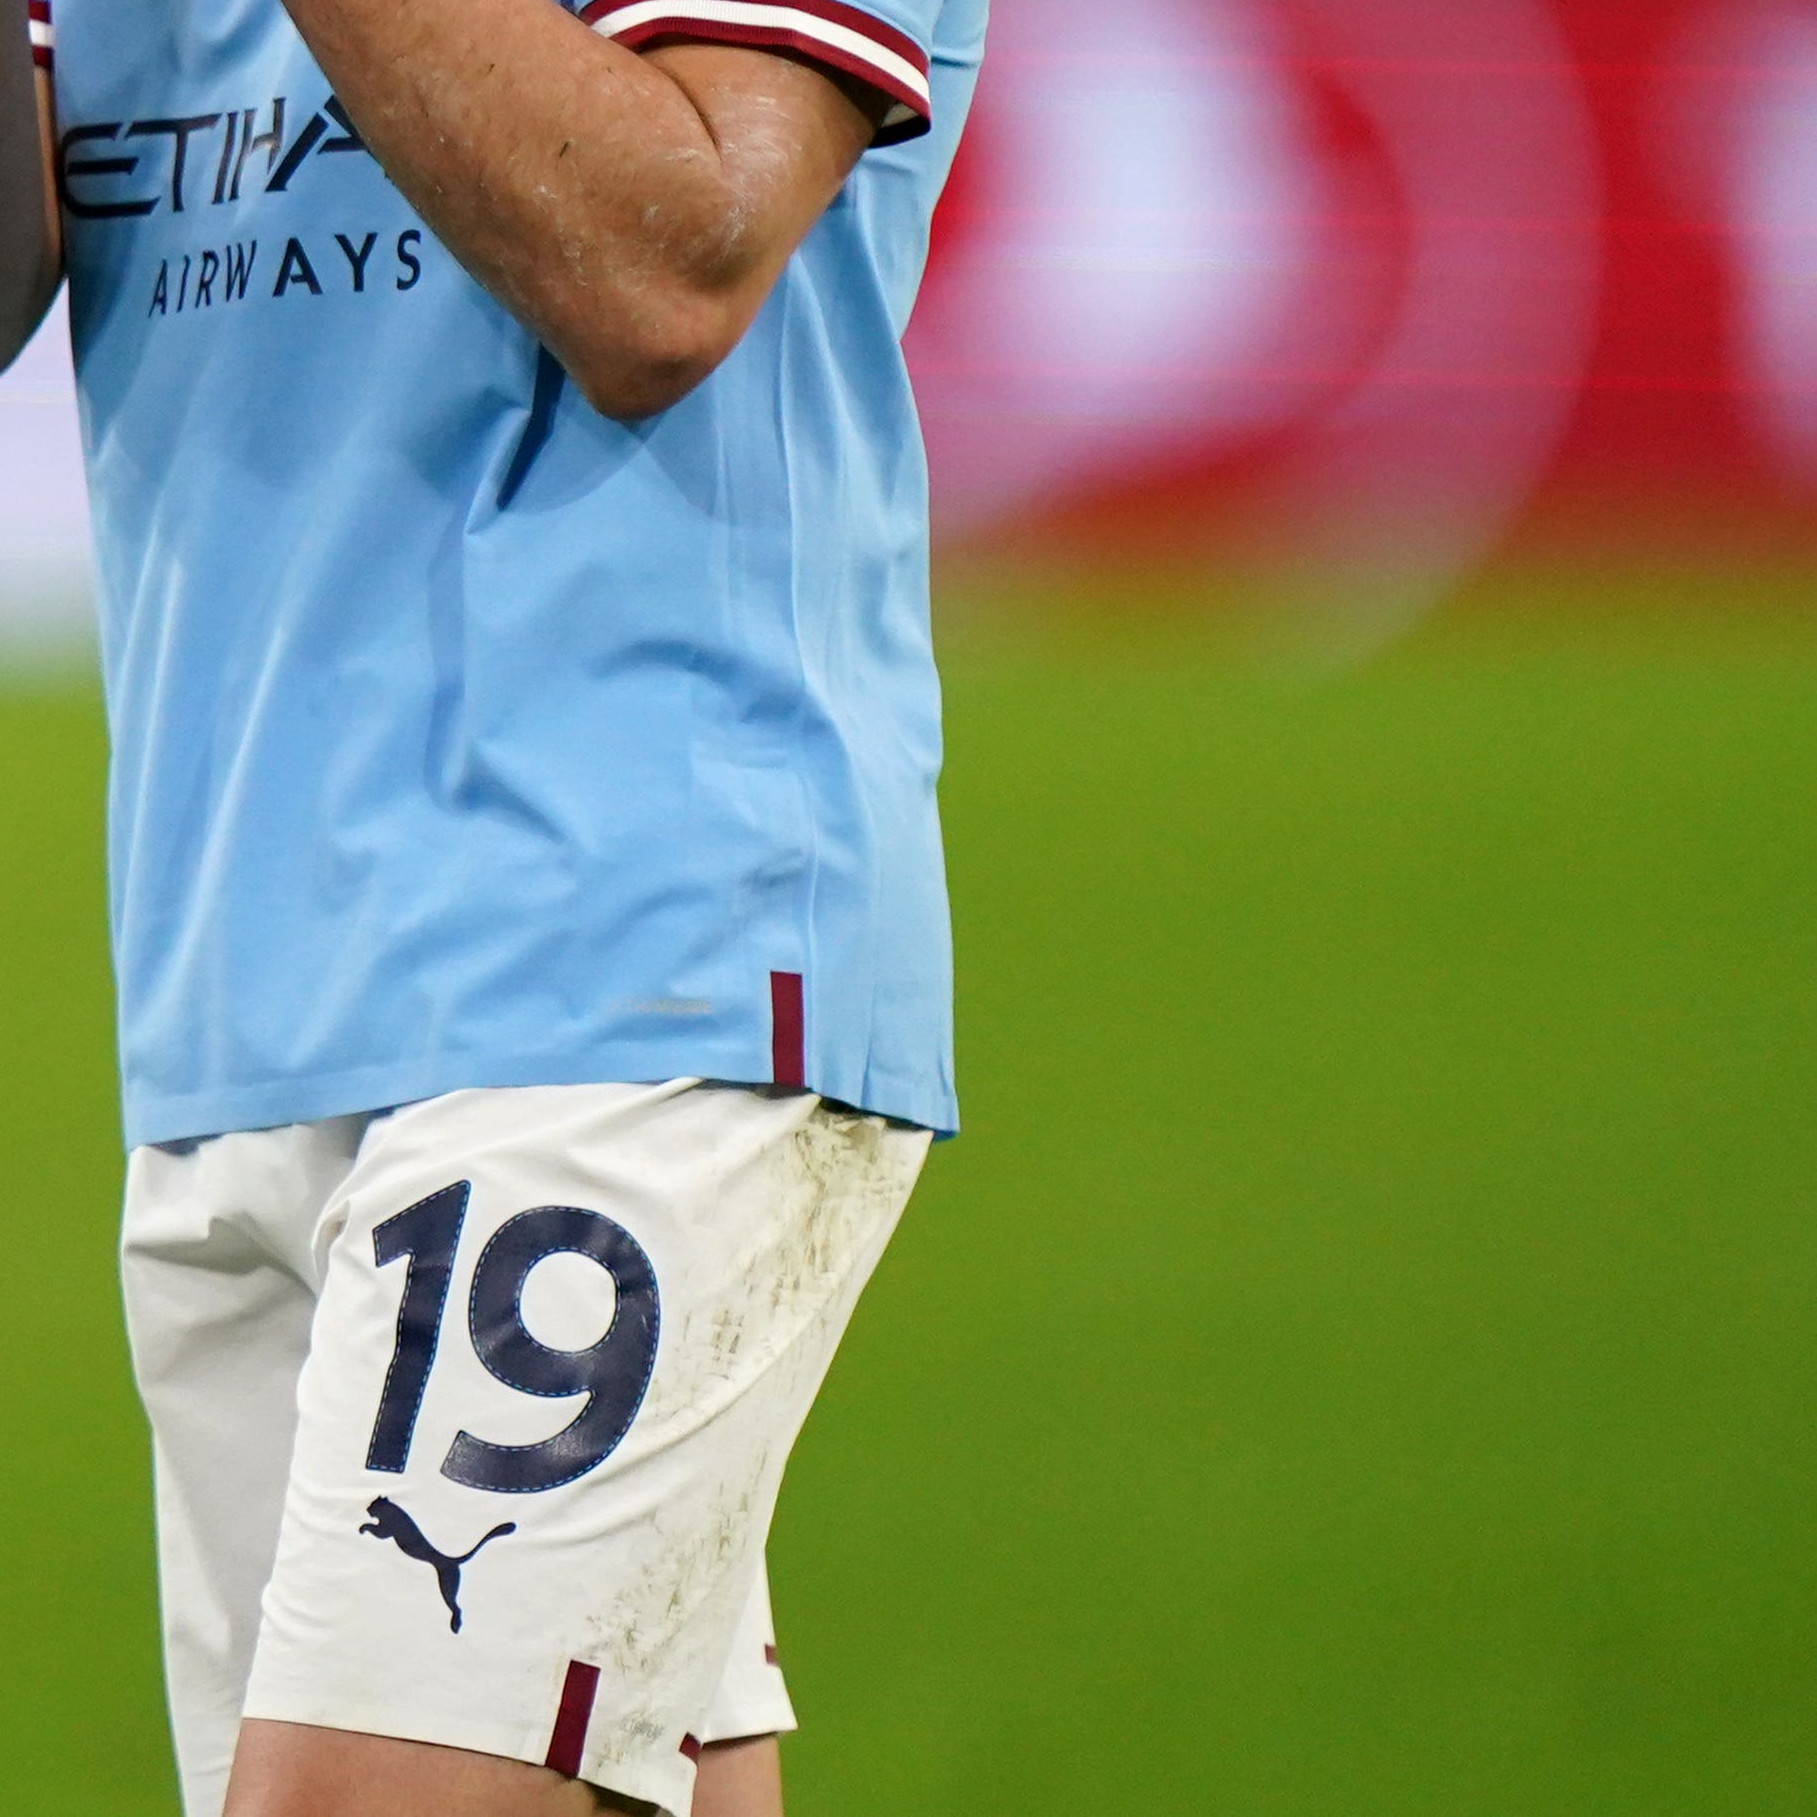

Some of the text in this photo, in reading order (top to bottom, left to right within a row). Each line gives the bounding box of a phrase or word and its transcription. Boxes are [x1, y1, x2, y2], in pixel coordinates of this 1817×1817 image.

[59, 95, 372, 220] ETIHA
[148, 229, 422, 318] AIRWAYS
[366, 1180, 660, 1493] 19
